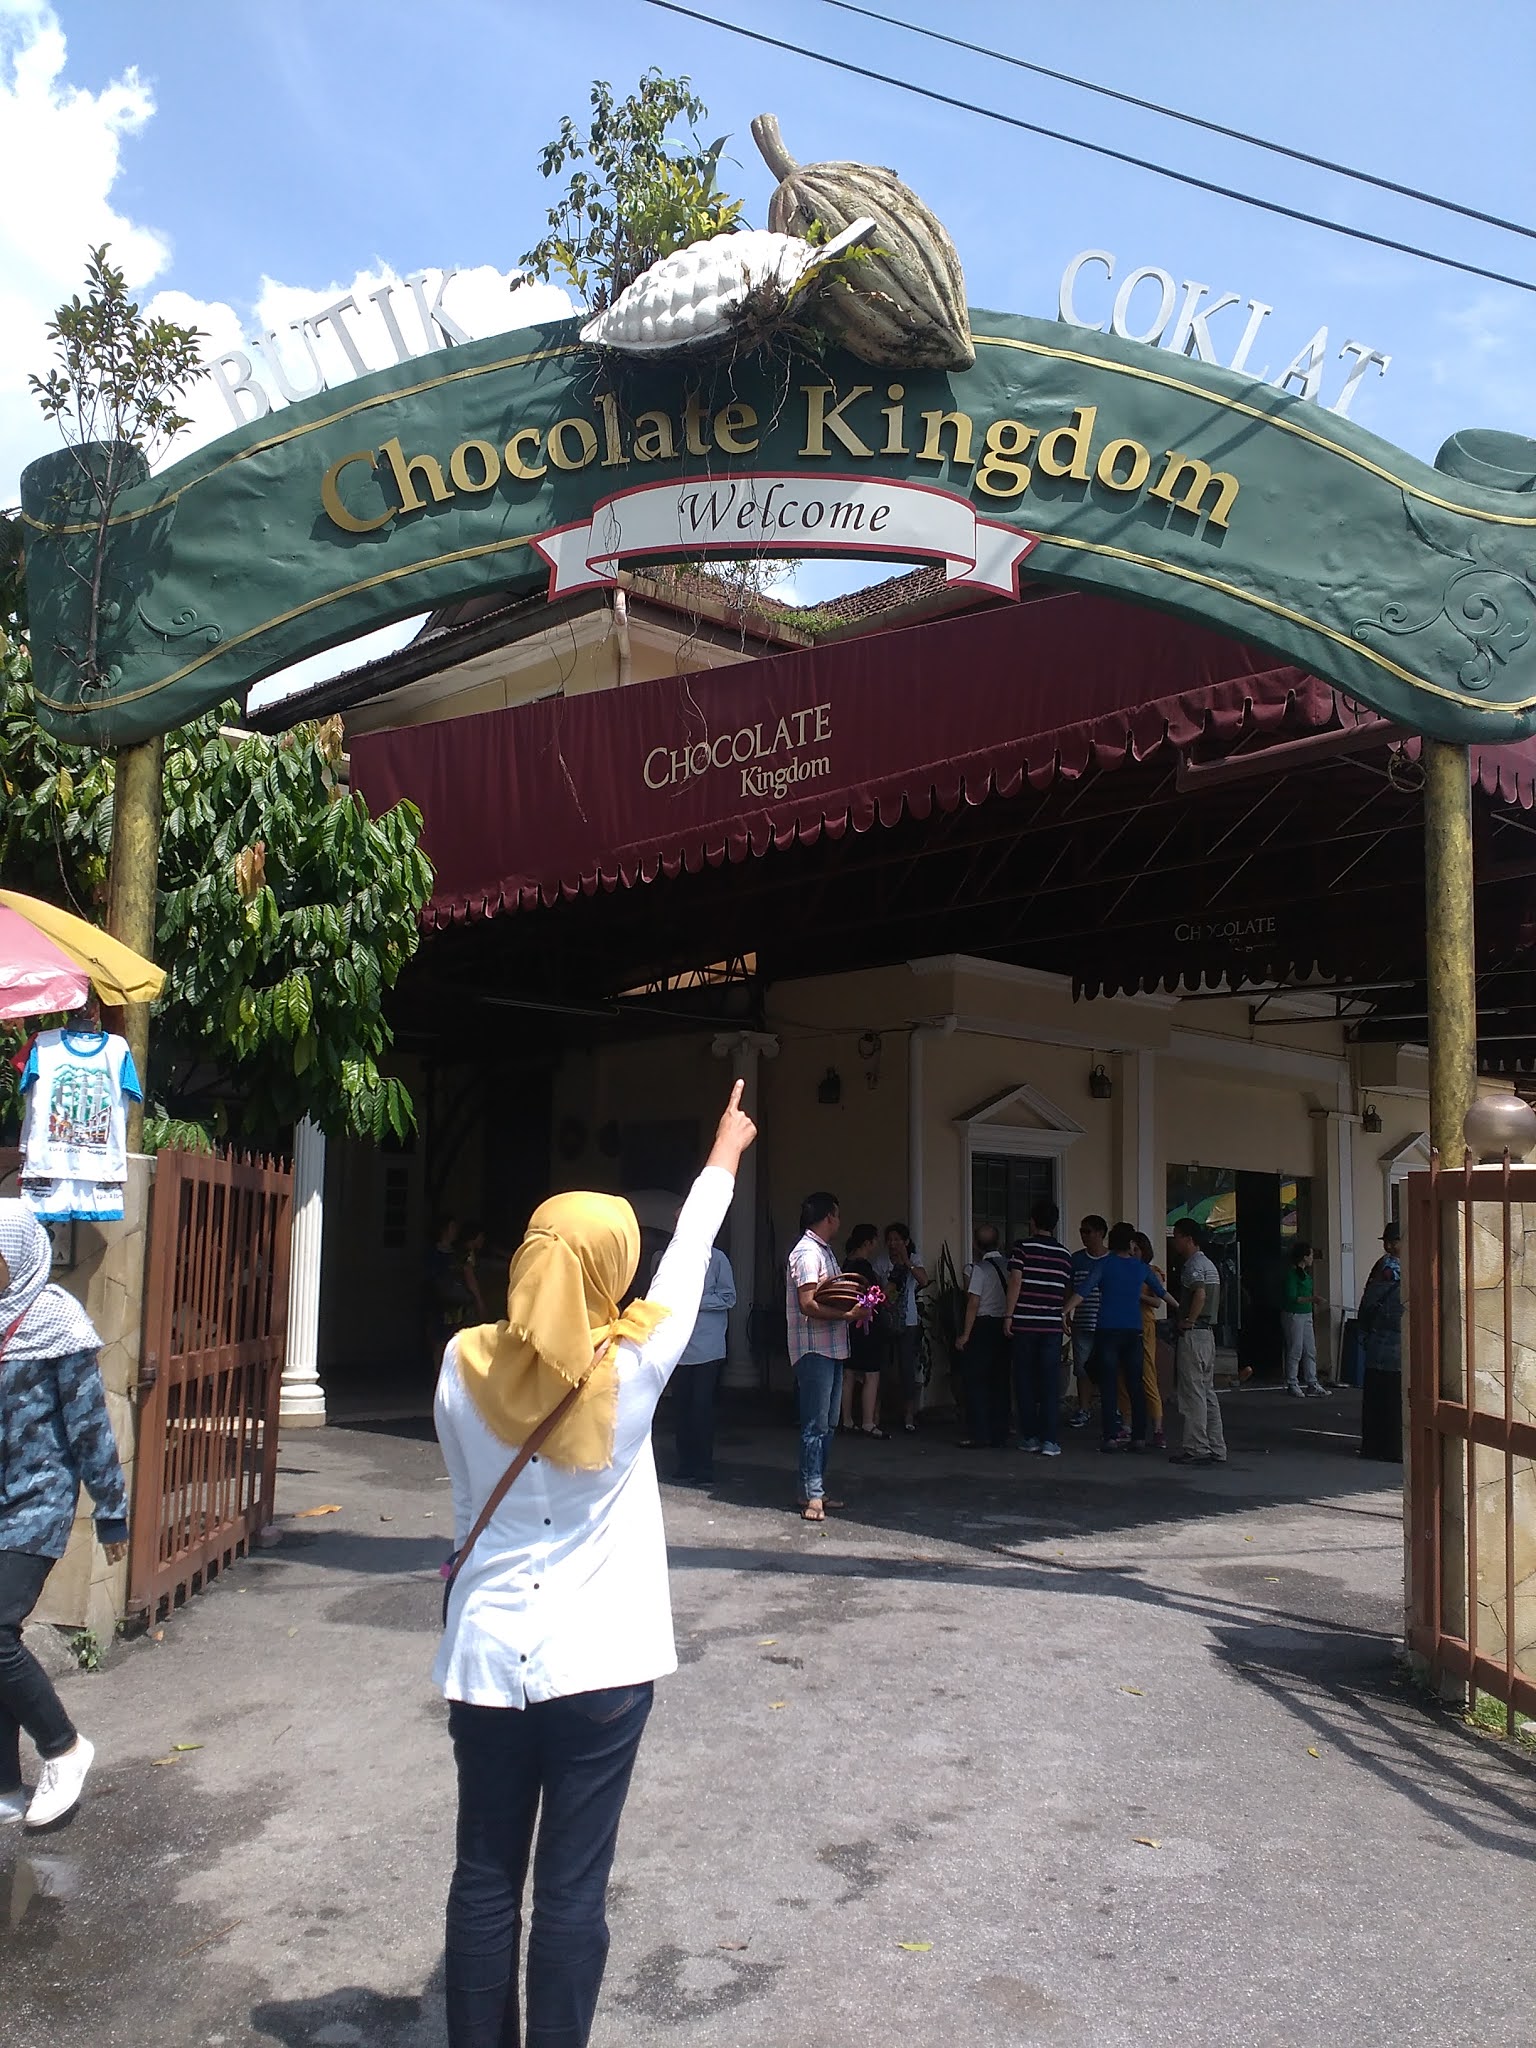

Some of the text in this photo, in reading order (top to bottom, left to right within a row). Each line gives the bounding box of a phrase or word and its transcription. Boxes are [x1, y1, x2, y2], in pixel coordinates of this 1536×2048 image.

[204, 249, 1392, 428] BUTIK COKLAT
[320, 383, 1240, 533] Chocolate Kingdom
[681, 483, 891, 533] Welcome
[643, 702, 833, 790] CHOCOLATE
[739, 756, 831, 800] Kingdom
